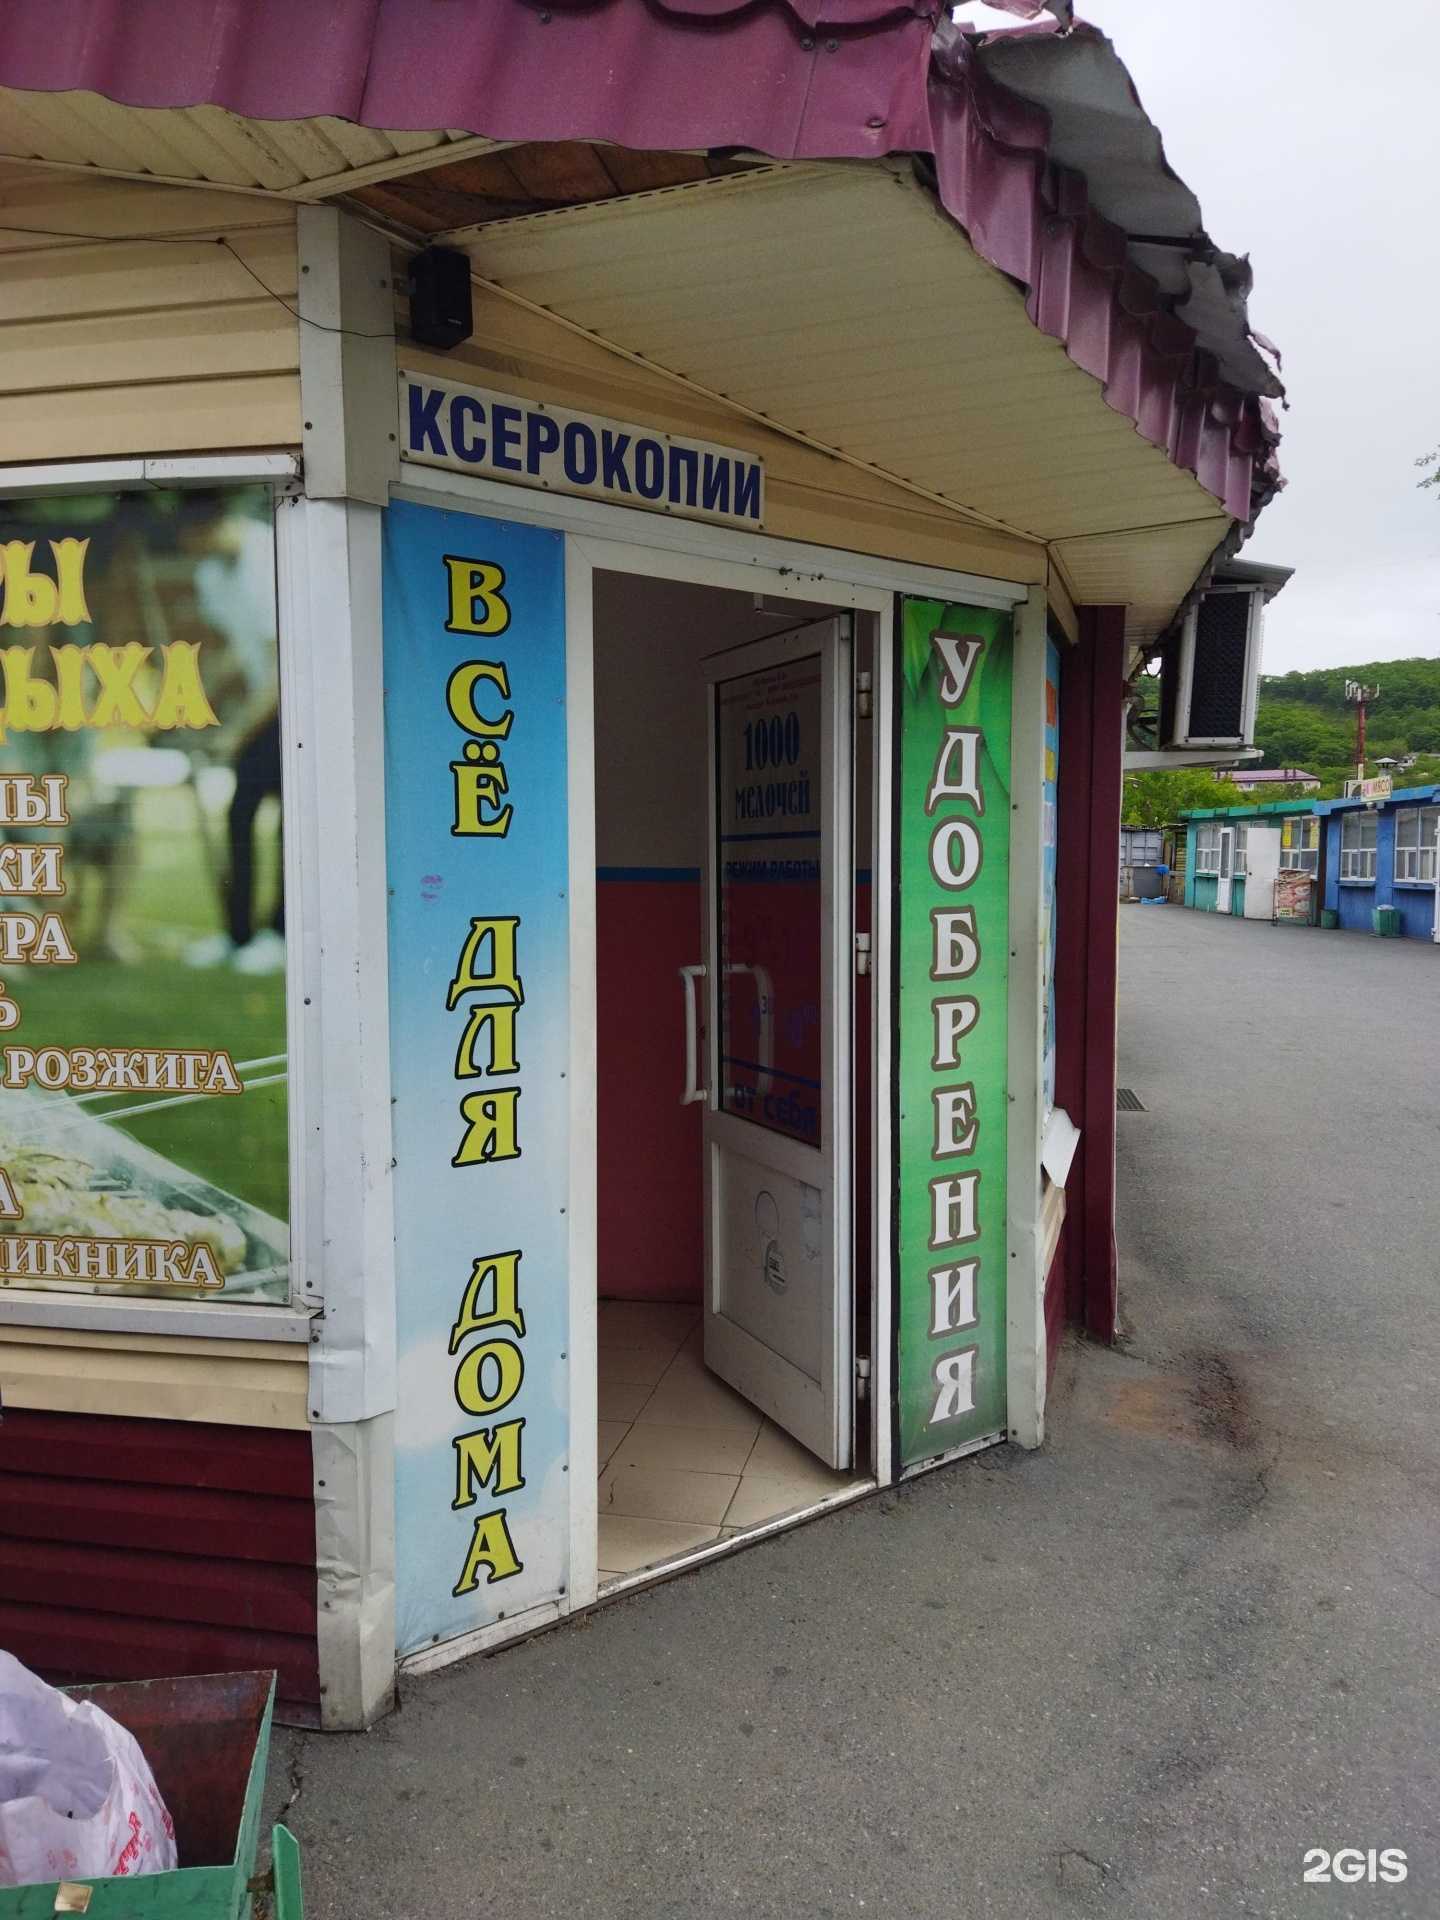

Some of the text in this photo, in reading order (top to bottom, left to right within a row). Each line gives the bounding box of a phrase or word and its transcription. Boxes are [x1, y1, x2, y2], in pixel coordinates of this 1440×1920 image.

[408, 383, 761, 520] КСЕРОКОПИИ
[0, 537, 92, 627] Ы
[0, 641, 221, 746] ЫХА
[743, 711, 800, 771] 1000
[0, 912, 78, 964] РА
[4, 1046, 243, 1093] РОЗЖИГА
[925, 630, 985, 1425] УДОБРЕНИЯ
[442, 554, 526, 1598] ВСЁ ДЛЯ ДОМА
[0, 1234, 225, 1288] ИКНИКА
